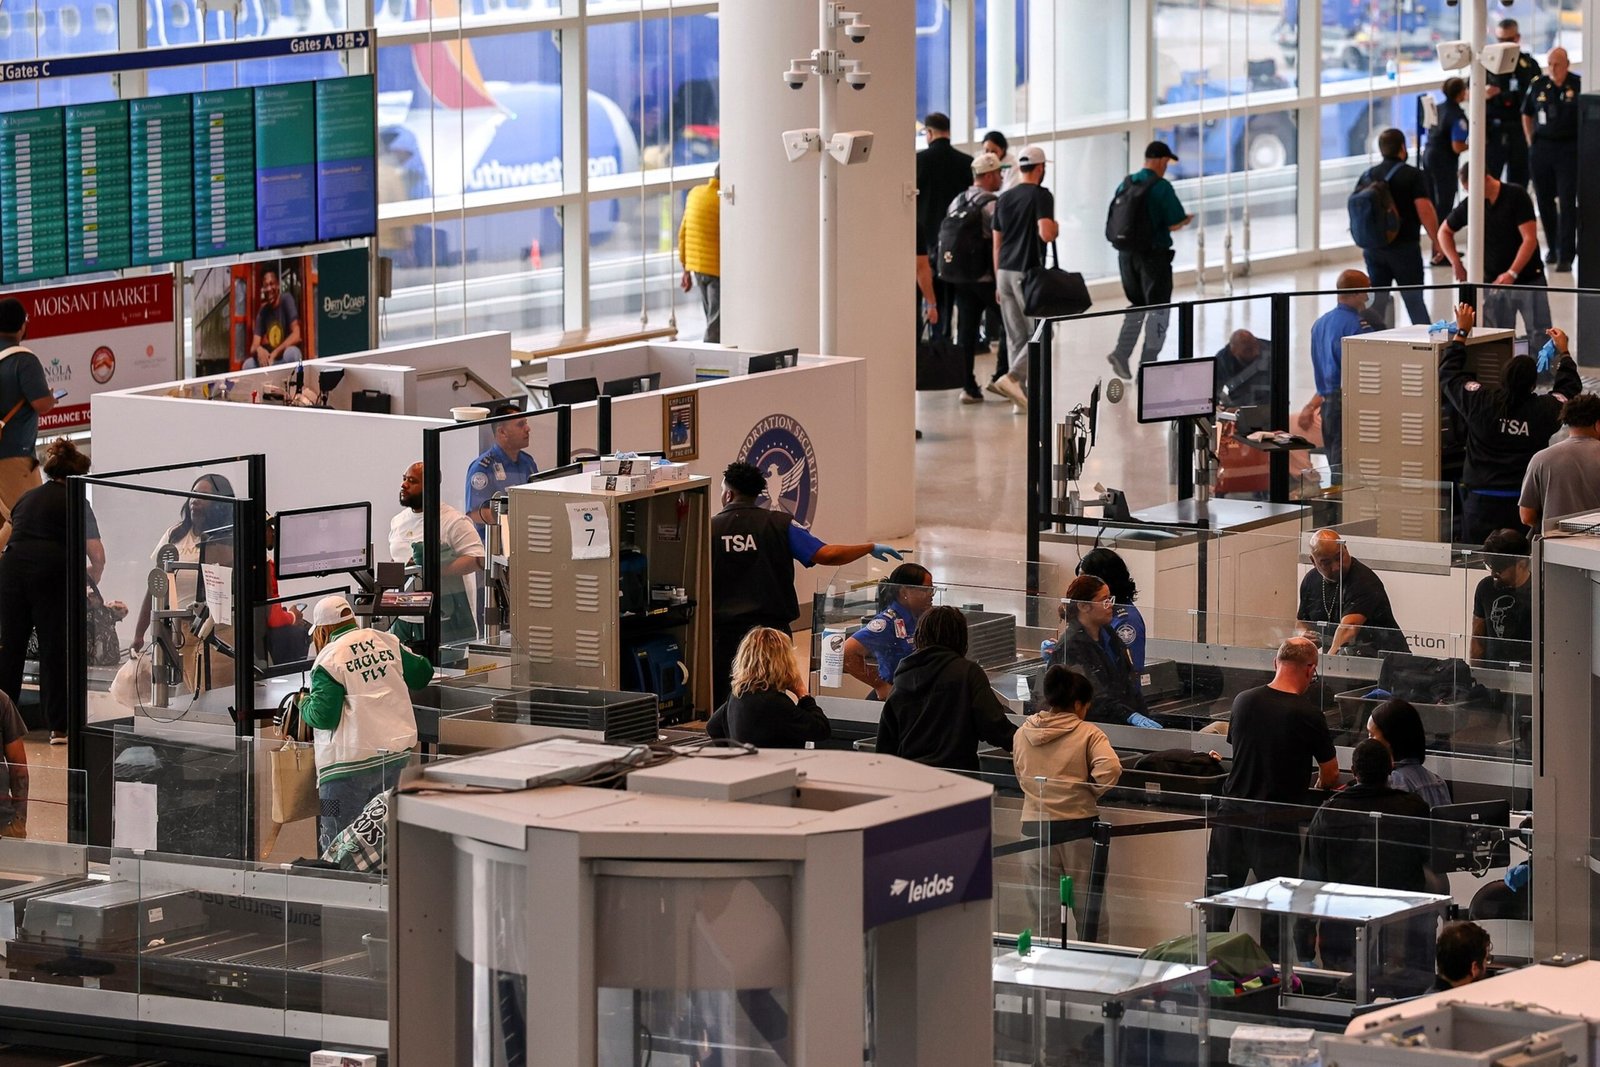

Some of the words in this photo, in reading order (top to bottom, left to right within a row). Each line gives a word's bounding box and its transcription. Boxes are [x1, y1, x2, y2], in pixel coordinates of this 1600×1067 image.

[290, 38, 321, 53] Gates
[324, 35, 335, 50] A,
[336, 34, 344, 48] B
[6, 64, 39, 79] Gates
[42, 61, 50, 76] C
[34, 291, 99, 317] MOISANT
[102, 283, 160, 308] MARKET
[44, 364, 71, 377] NOLA
[38, 411, 80, 427] ENTRANCE
[1499, 418, 1529, 437] TSA
[737, 415, 794, 463] SPORTATION
[793, 425, 818, 494] SECURITY
[585, 529, 596, 547] 7
[721, 534, 758, 552] TSA
[349, 639, 376, 656] FLY
[345, 649, 395, 673] EAGLES
[361, 664, 388, 683] FLY
[908, 873, 955, 904] leidos
